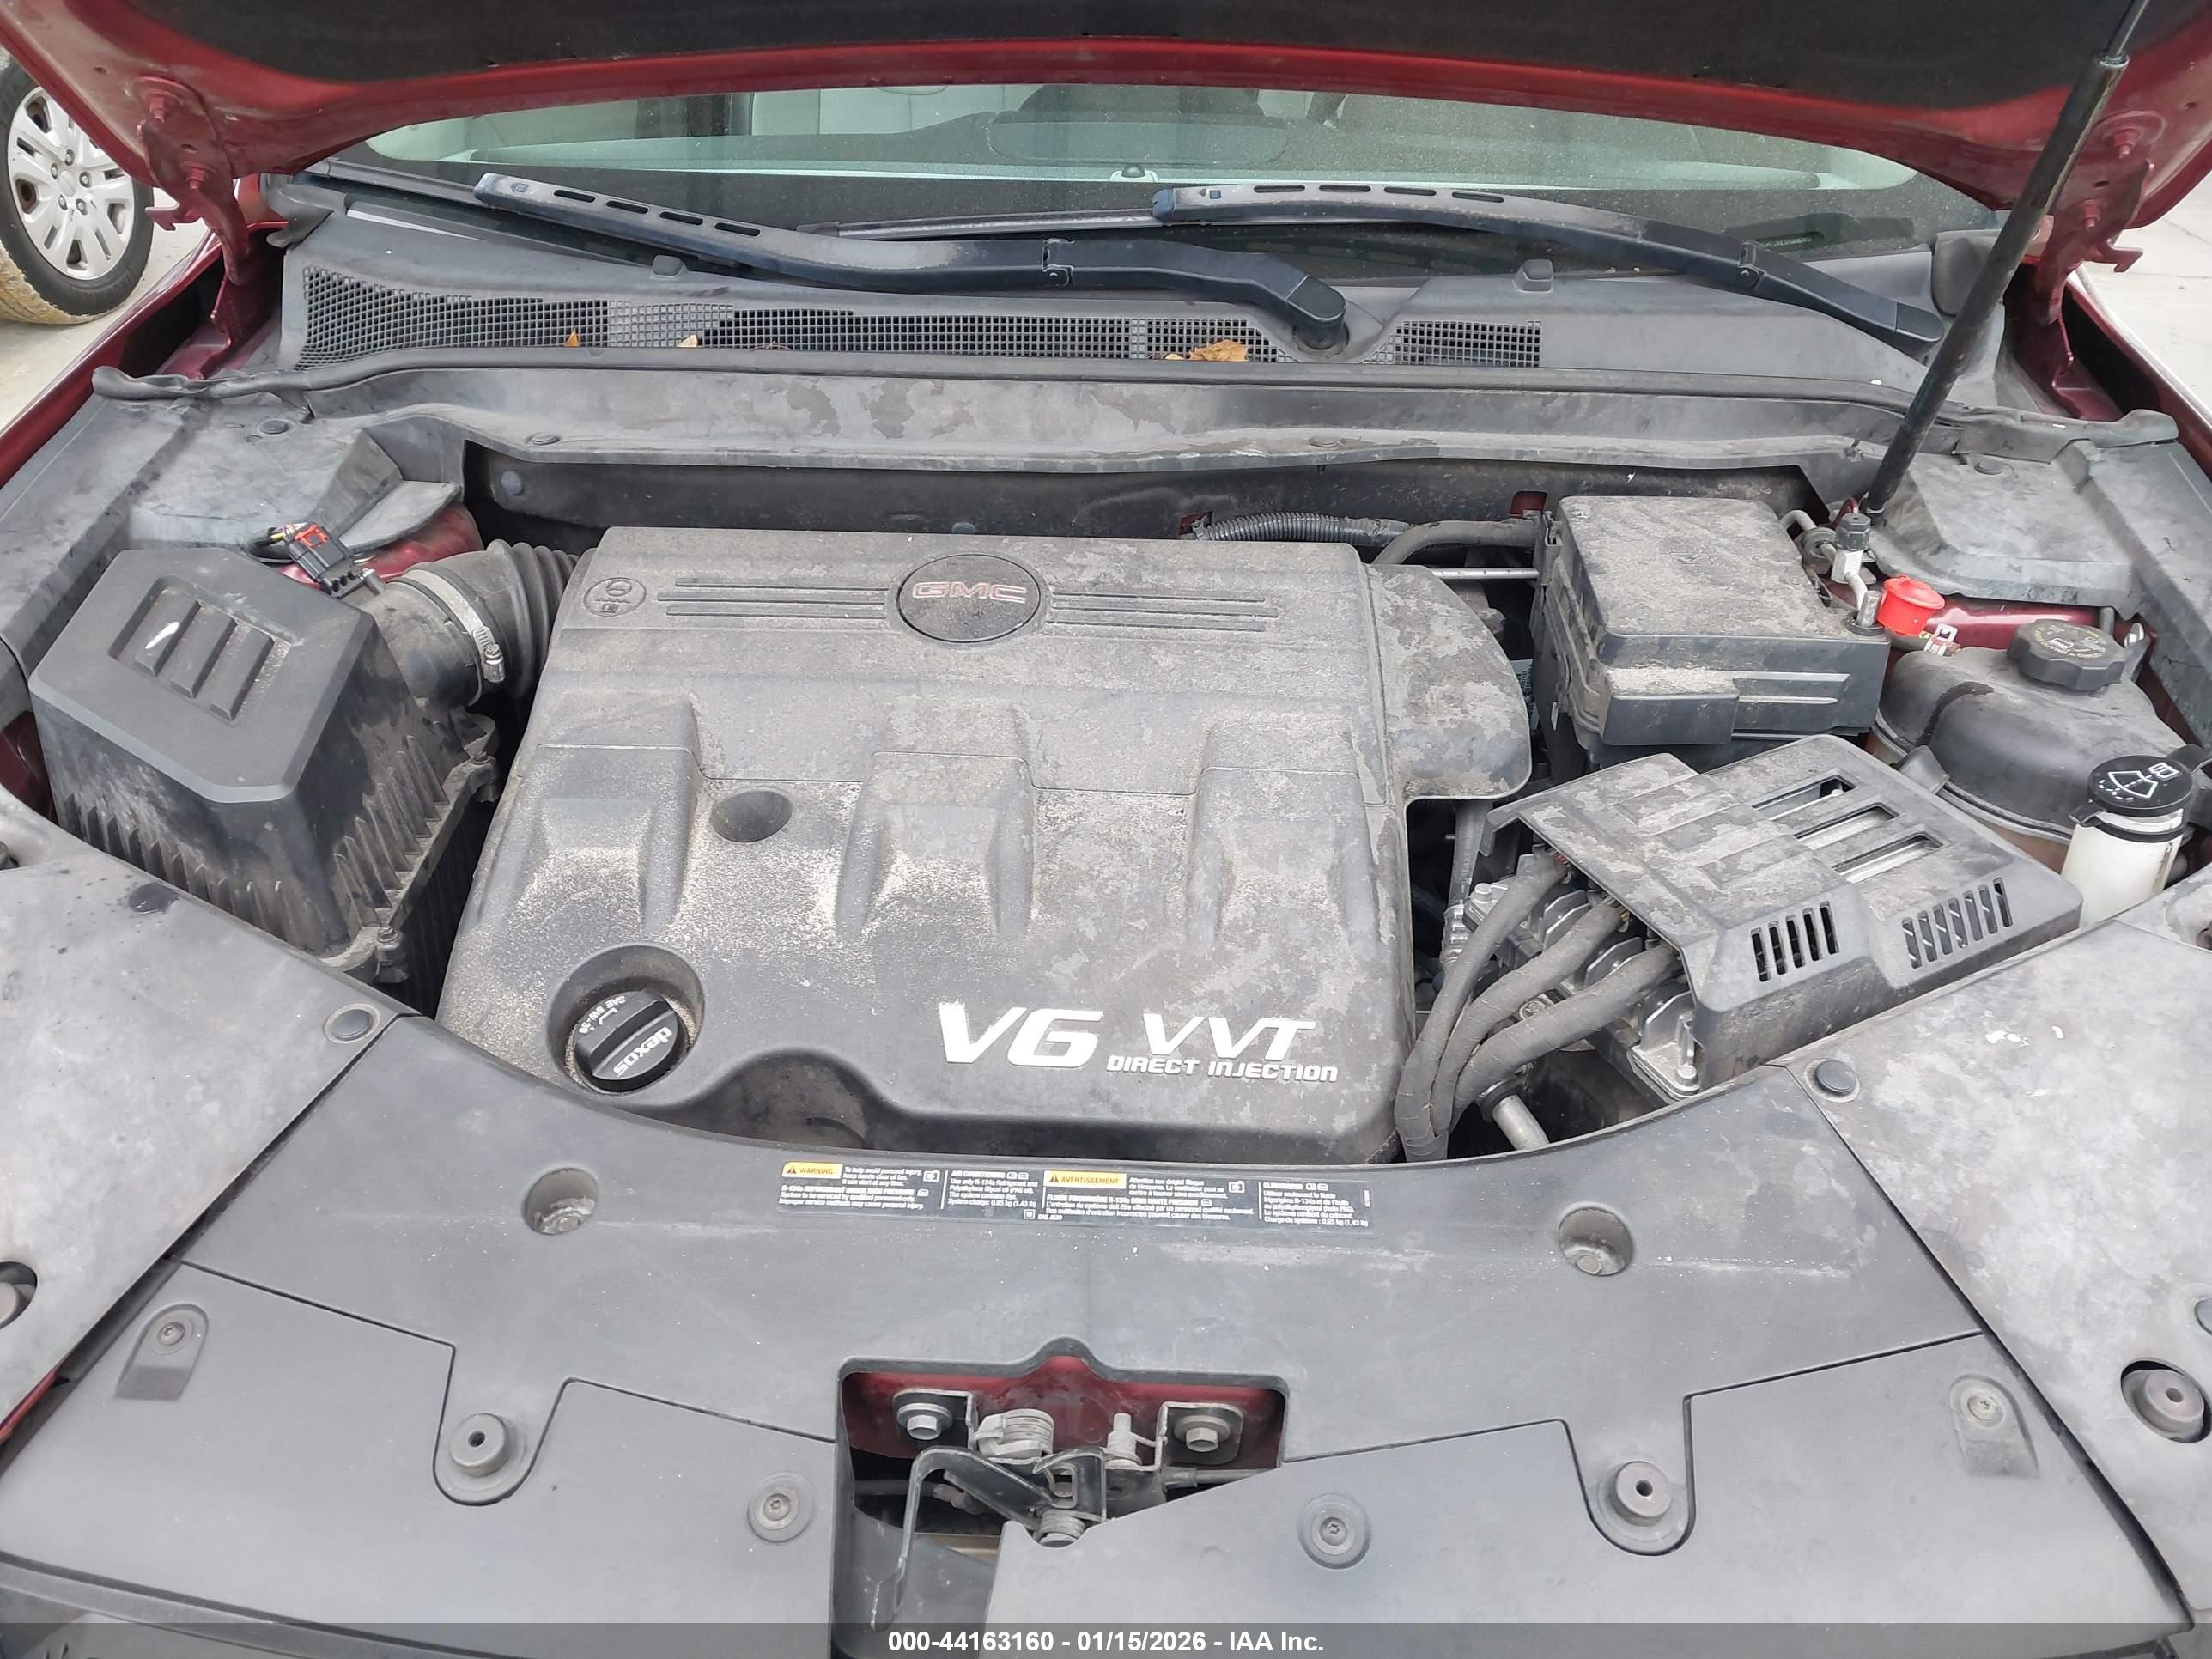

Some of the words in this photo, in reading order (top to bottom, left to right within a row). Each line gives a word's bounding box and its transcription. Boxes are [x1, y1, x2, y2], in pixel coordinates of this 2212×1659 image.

[913, 581, 1027, 604] GMC
[604, 995, 626, 1009] SAE
[939, 1002, 1103, 1068] V6
[1143, 1013, 1316, 1060] VVT
[612, 1026, 672, 1077] dexos
[1106, 1055, 1200, 1075] DIRECT
